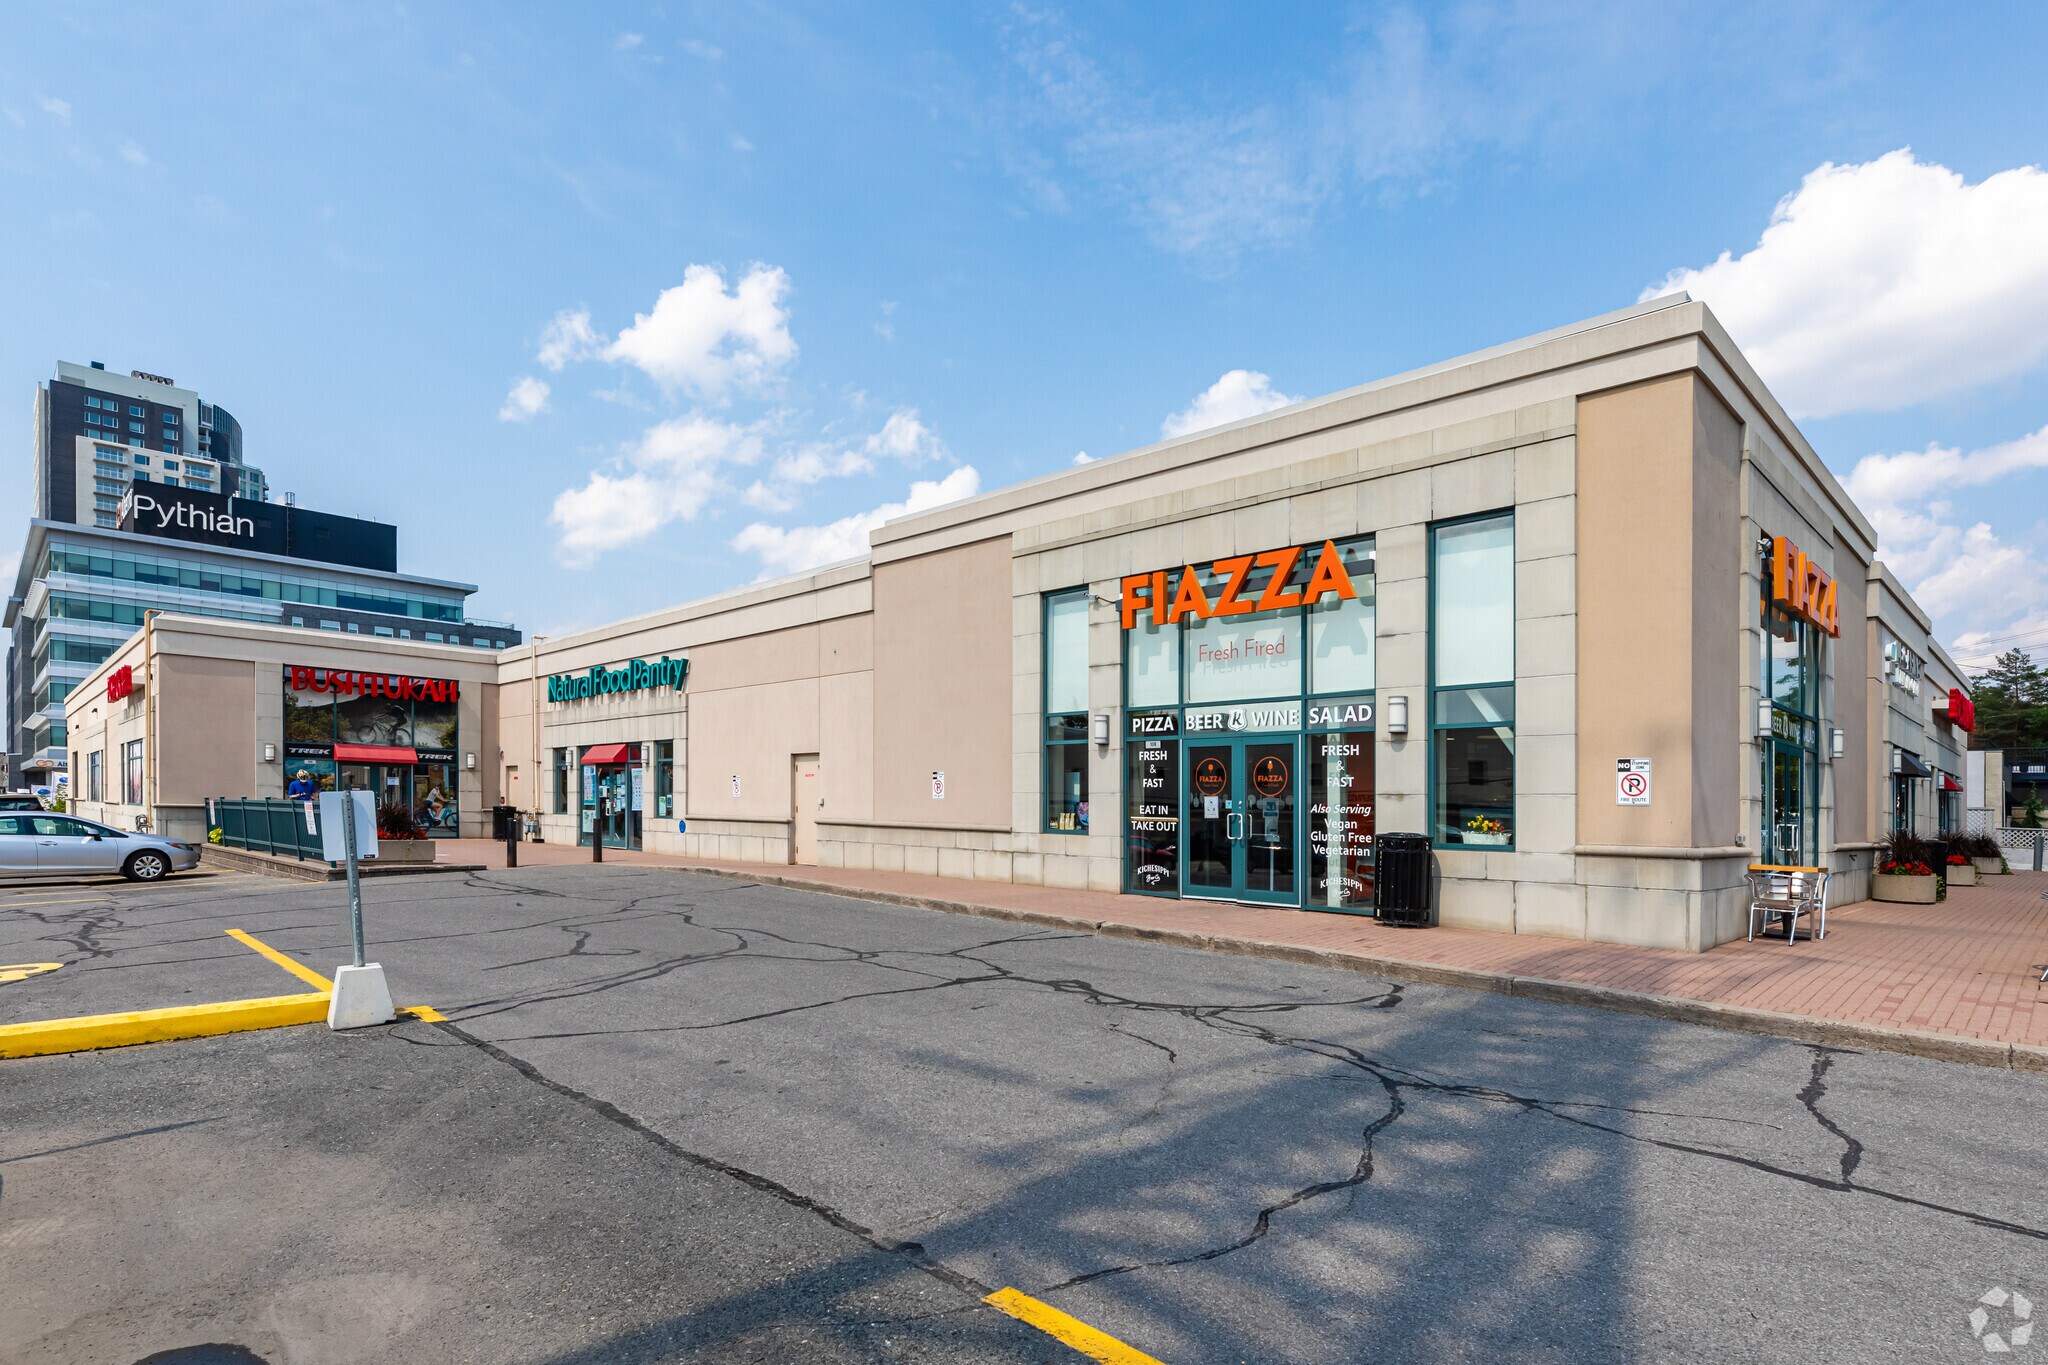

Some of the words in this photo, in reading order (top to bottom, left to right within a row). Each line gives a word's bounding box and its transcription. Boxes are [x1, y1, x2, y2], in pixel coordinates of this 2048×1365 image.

[134, 494, 254, 537] Pythian
[1122, 539, 1358, 629] FIAZZA
[1772, 536, 1840, 637] FIAZZA
[1199, 641, 1239, 662] Fresh
[1245, 635, 1285, 657] Fired
[290, 667, 458, 703] BUSHTUKAH
[548, 668, 593, 703] Natural
[594, 660, 631, 695] Food
[631, 655, 689, 691] Pantry
[1186, 713, 1223, 730] BEER
[1251, 709, 1300, 727] WINE
[1309, 704, 1373, 724] SALAD
[1132, 716, 1174, 732] PIZZA
[289, 747, 330, 755] TREK
[1139, 750, 1168, 761] FRESH
[1321, 744, 1360, 757] FRESH
[1149, 763, 1157, 774] &
[1336, 760, 1345, 771] &
[1142, 778, 1164, 788] FAST
[1199, 775, 1222, 783] FIAZZA
[1327, 776, 1354, 788] FAST
[1139, 805, 1157, 815] EAT
[1158, 805, 1169, 815] IN
[1310, 804, 1331, 814] Also
[1334, 804, 1371, 817] Serving
[1131, 820, 1155, 831] TAKE
[1156, 821, 1177, 832] OUT
[1324, 818, 1358, 831] Vegan
[1310, 831, 1345, 842] Gluten
[1348, 832, 1372, 843] Free
[1312, 844, 1371, 858] Vegetarian
[1320, 877, 1363, 892] KICHESIPPI
